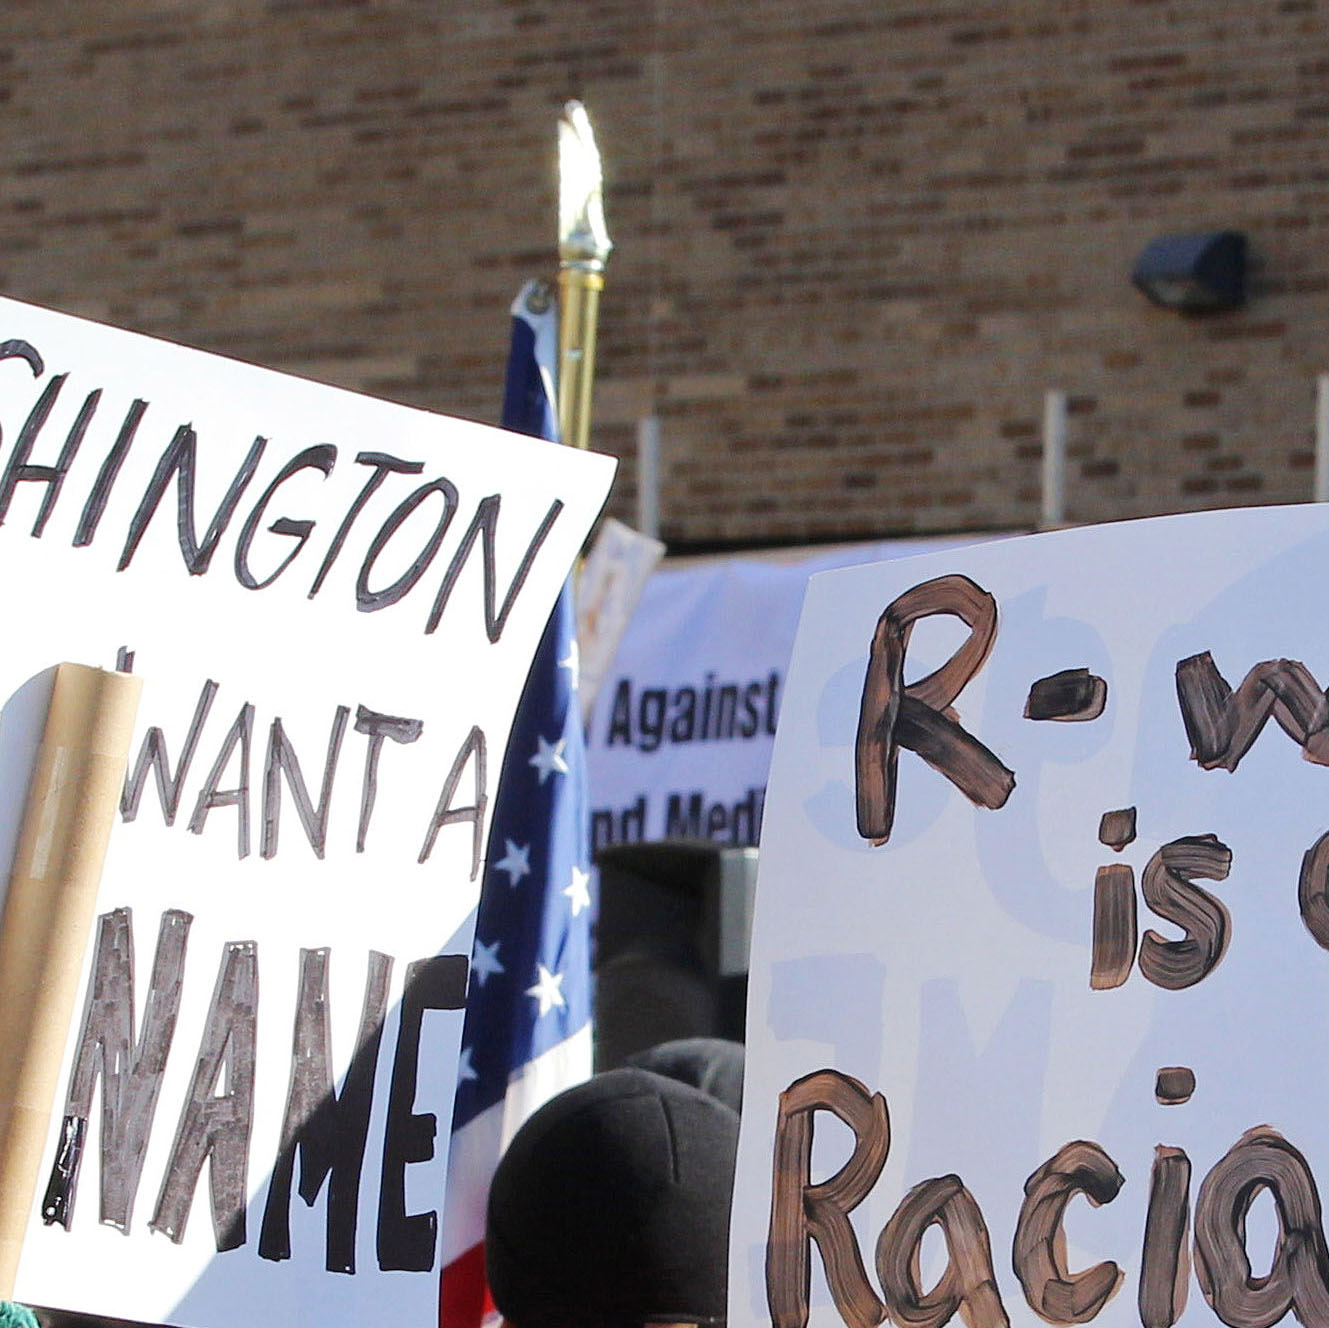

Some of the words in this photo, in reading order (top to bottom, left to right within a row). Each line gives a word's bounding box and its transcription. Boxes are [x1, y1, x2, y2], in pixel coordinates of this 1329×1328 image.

[117, 647, 424, 861] WANT
[418, 725, 489, 881] A
[607, 669, 782, 751] Against
[591, 793, 646, 847] nd
[1090, 805, 1233, 989] is
[42, 907, 469, 1276] NAME
